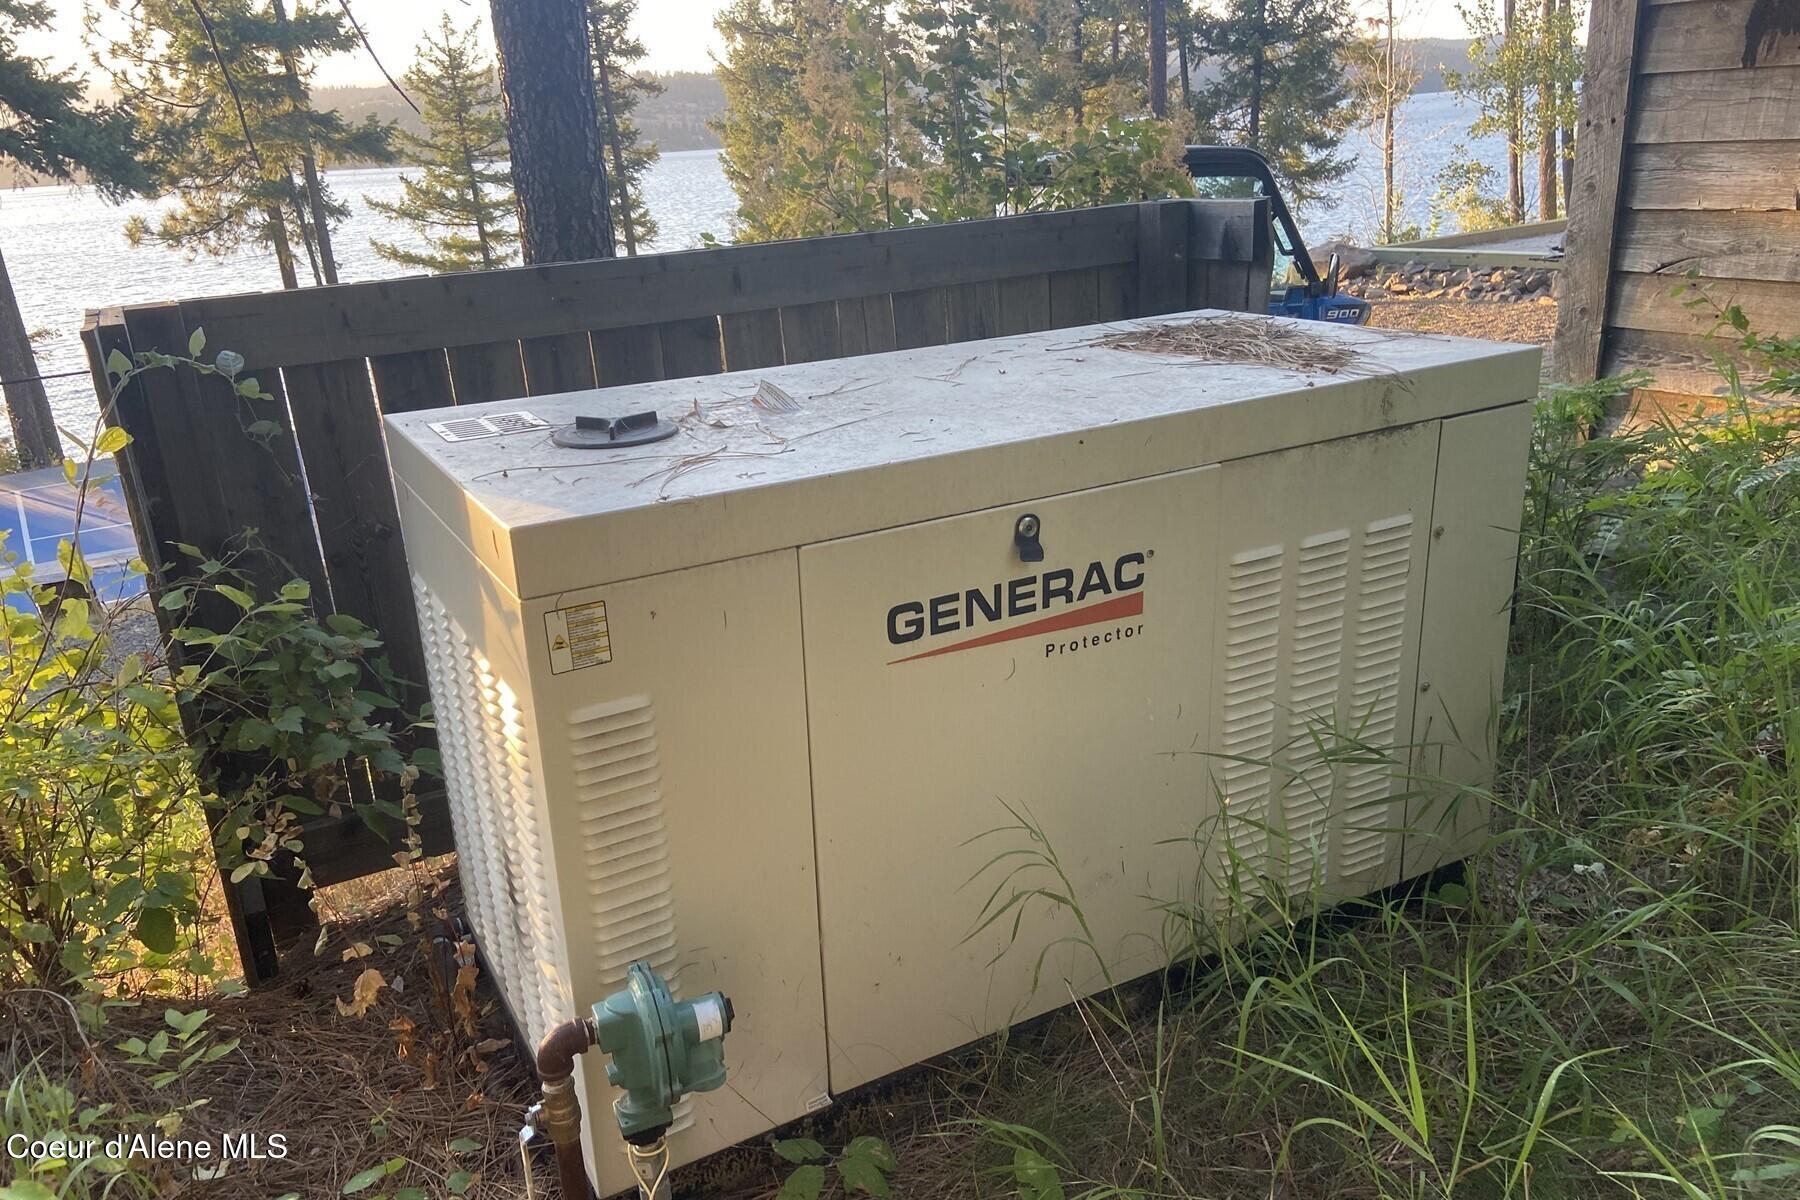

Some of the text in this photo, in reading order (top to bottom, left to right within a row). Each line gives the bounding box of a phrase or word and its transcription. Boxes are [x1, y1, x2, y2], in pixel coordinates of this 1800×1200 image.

[1327, 309, 1360, 320] 900
[886, 551, 1145, 645] GENERAC
[1045, 624, 1144, 658] Protector
